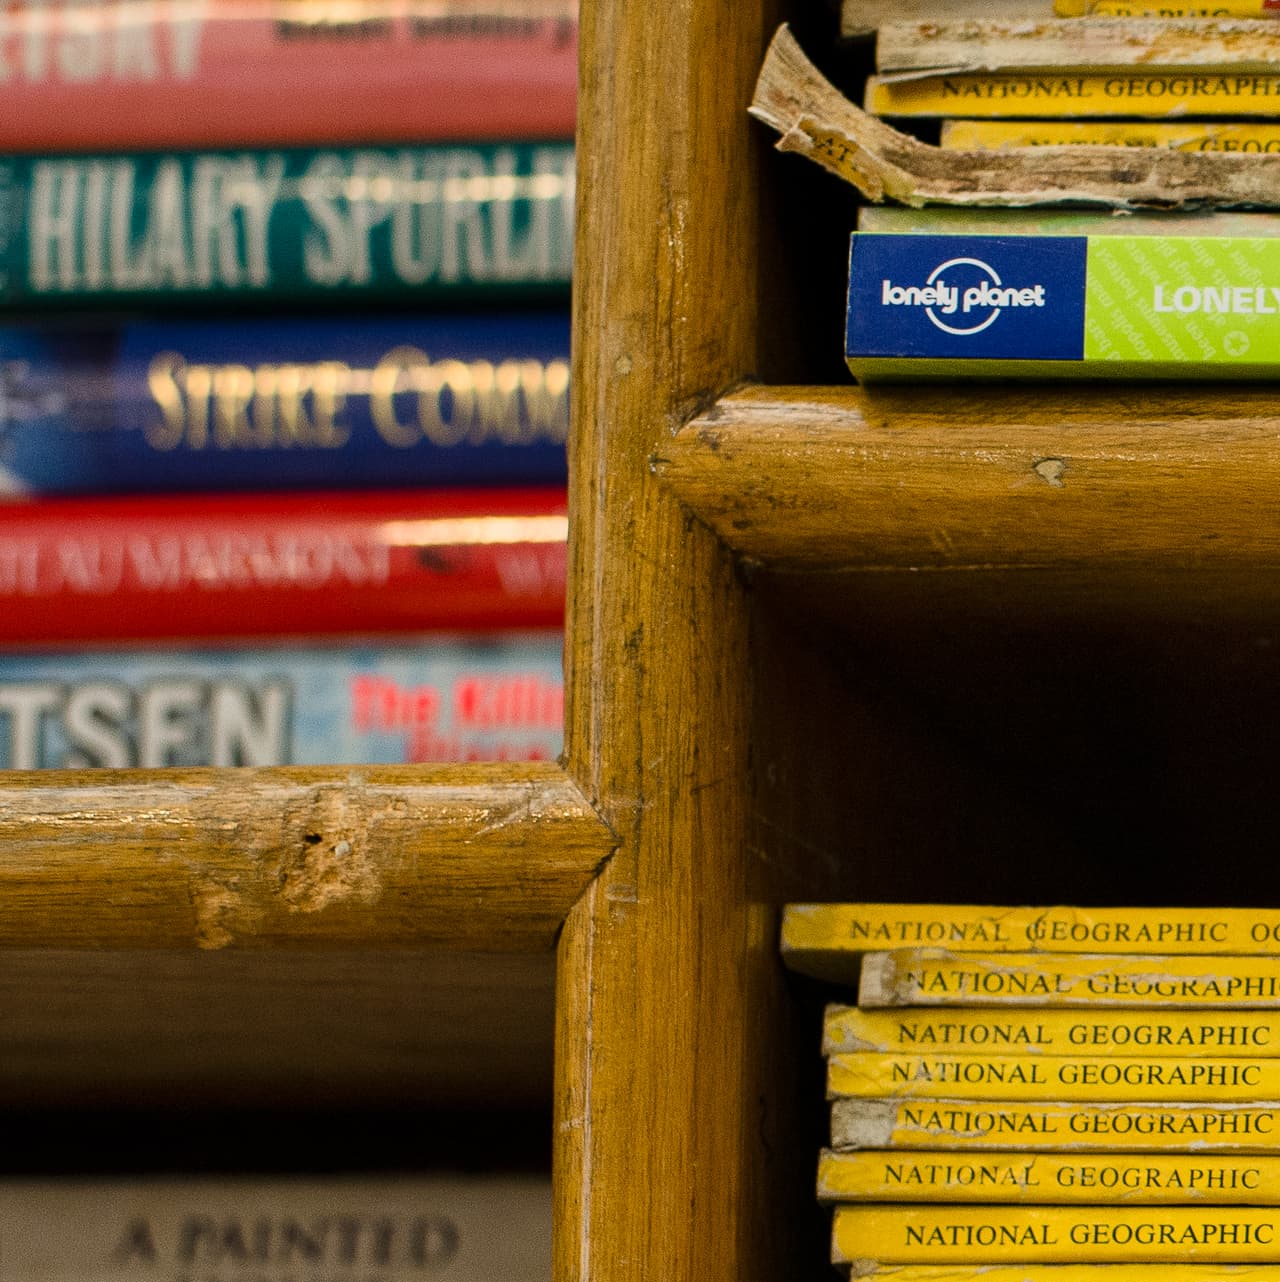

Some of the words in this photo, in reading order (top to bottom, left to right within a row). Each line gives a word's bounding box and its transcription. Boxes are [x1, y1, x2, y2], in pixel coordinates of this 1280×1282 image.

[940, 78, 1093, 99] NATIONAL
[28, 156, 285, 290] HILARY
[882, 279, 960, 311] lonely
[963, 281, 1047, 309] planet
[851, 920, 1001, 942] NATIONAL
[1025, 916, 1228, 943] GEOGRAPHIC
[898, 1024, 1053, 1044] NATIONAL
[1068, 1025, 1271, 1045] GEOGRAPHIC
[112, 1215, 157, 1267] A
[178, 1213, 462, 1270] PAINTED
[905, 1225, 1058, 1246] NATIONAL
[1069, 1223, 1274, 1244] GEOGRAPHIC
